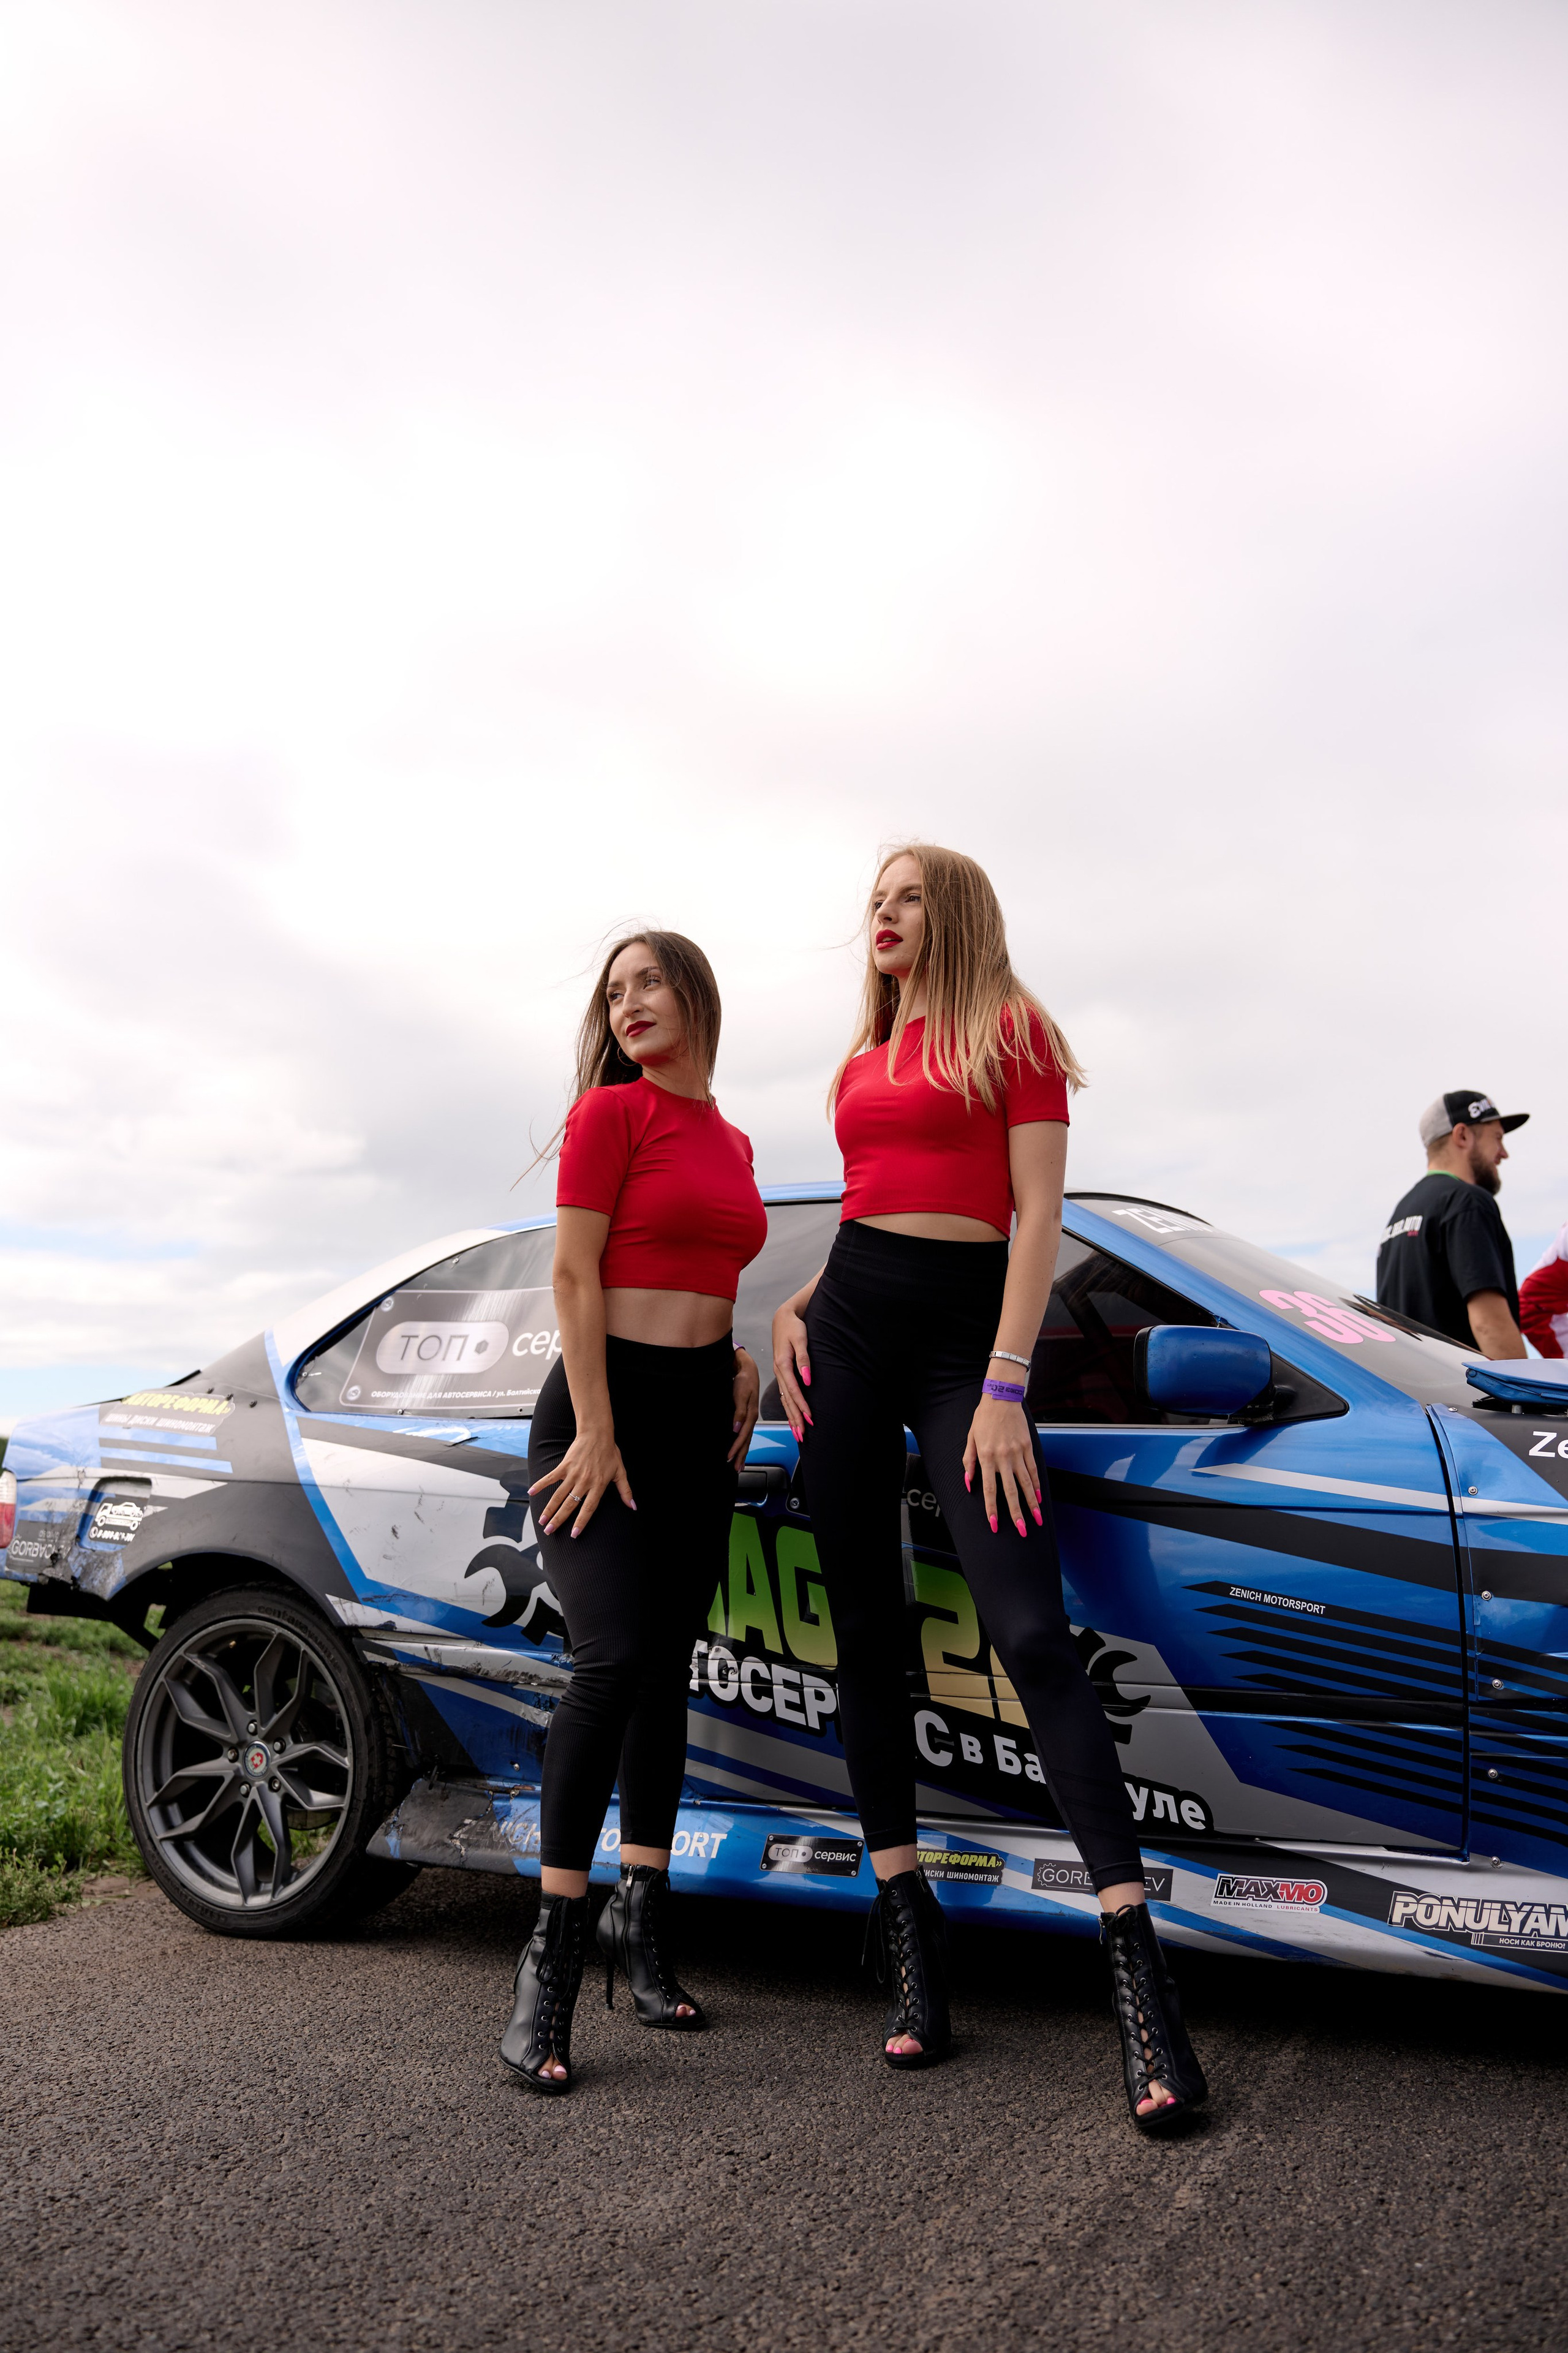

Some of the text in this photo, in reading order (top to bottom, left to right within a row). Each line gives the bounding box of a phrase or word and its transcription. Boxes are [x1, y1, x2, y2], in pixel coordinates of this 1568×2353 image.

[1259, 1290, 1396, 1344] 36
[400, 1334, 469, 1361] ТОП
[442, 1390, 492, 1399] АВТОСЕРВИСА
[507, 1388, 541, 1397] Балтийска
[1229, 1587, 1326, 1615] ZENICH MOTORSPORT
[707, 1512, 1030, 1729] AG 2
[959, 1732, 984, 1764] в
[993, 1734, 1207, 1831] Бауле
[775, 1847, 857, 1862] ТОП сервис
[918, 1851, 1003, 1868] ТОРЕФОРМА»
[1216, 1876, 1325, 1904] MAXMO
[1536, 1941, 1566, 1949] БРОНЮ!
